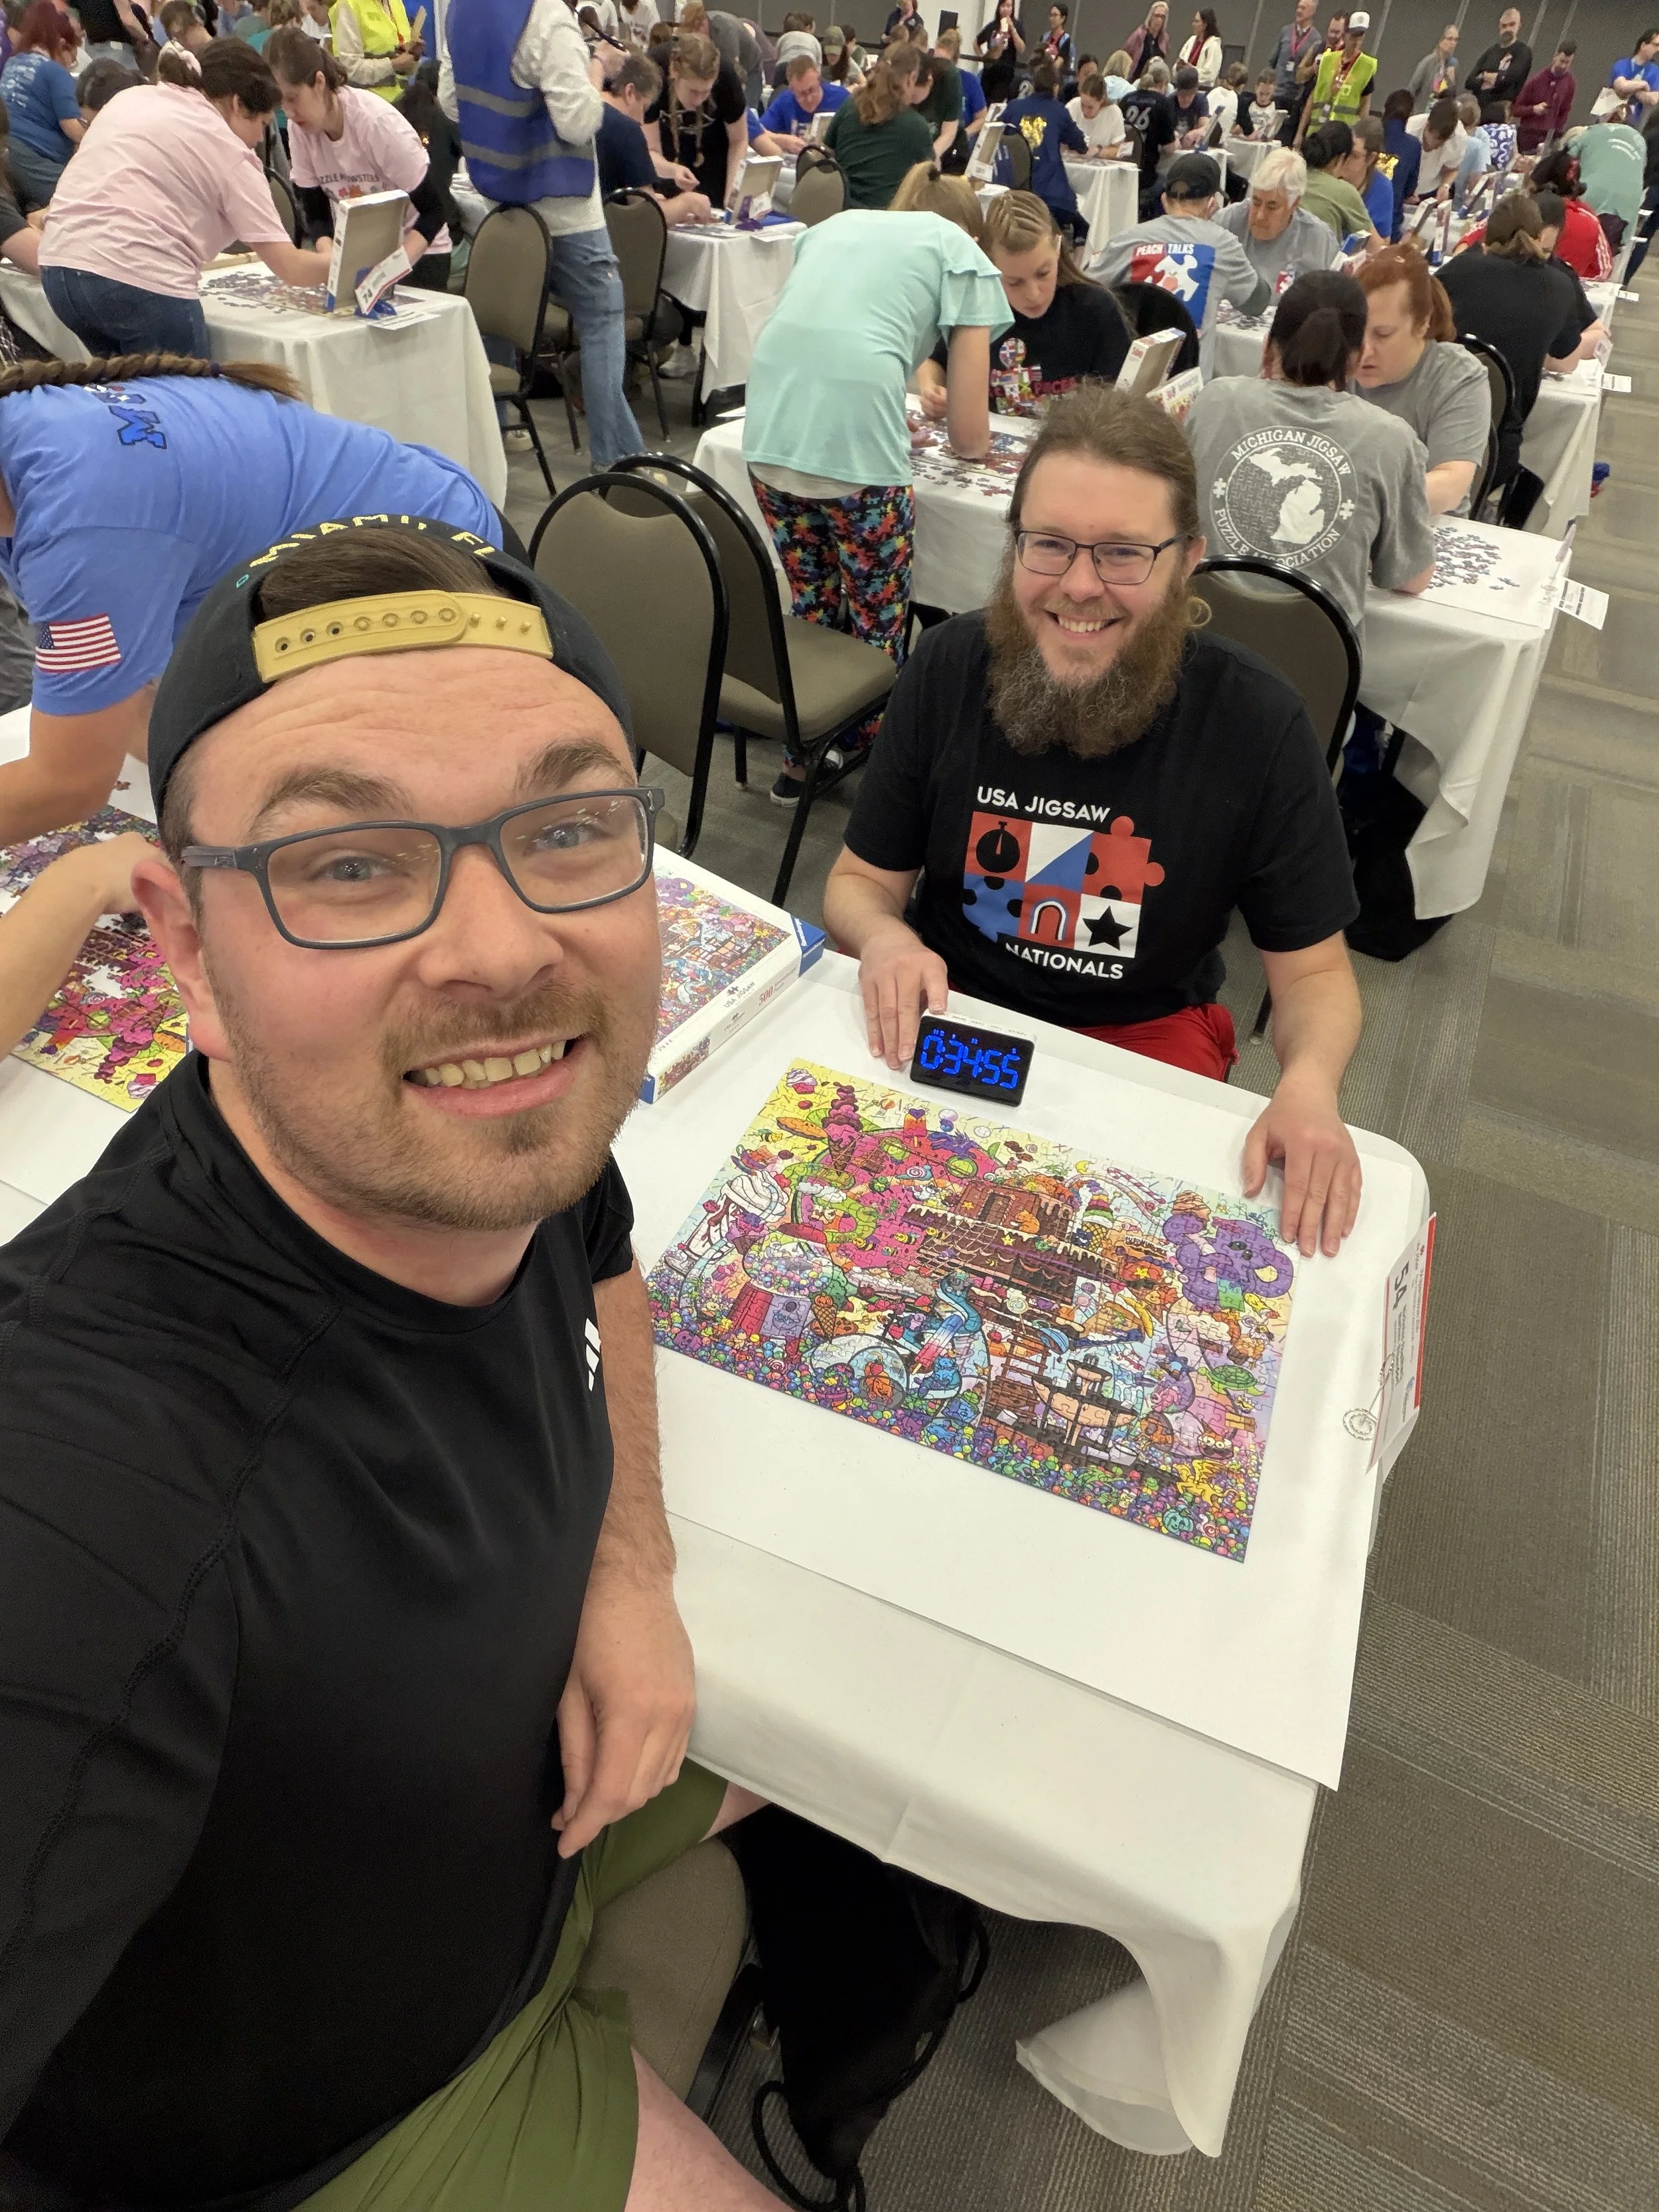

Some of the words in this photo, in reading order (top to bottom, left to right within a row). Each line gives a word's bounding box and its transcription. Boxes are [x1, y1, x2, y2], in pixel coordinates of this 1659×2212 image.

[1135, 244, 1163, 256] PEACH
[1168, 244, 1194, 254] TALKS
[1231, 429, 1306, 461] MICHIGAN
[1307, 435, 1351, 475] JIGSAW
[1214, 508, 1249, 556] PUZZLE
[1252, 530, 1340, 567] OCIATION
[976, 786, 1019, 810] USA
[1024, 796, 1111, 823] JIGSAW
[1005, 942, 1124, 980] NATIONALS
[723, 998, 737, 1008] USA
[737, 981, 756, 999] JIGSAW
[758, 986, 773, 1007] 500
[1393, 1260, 1409, 1310] 54
